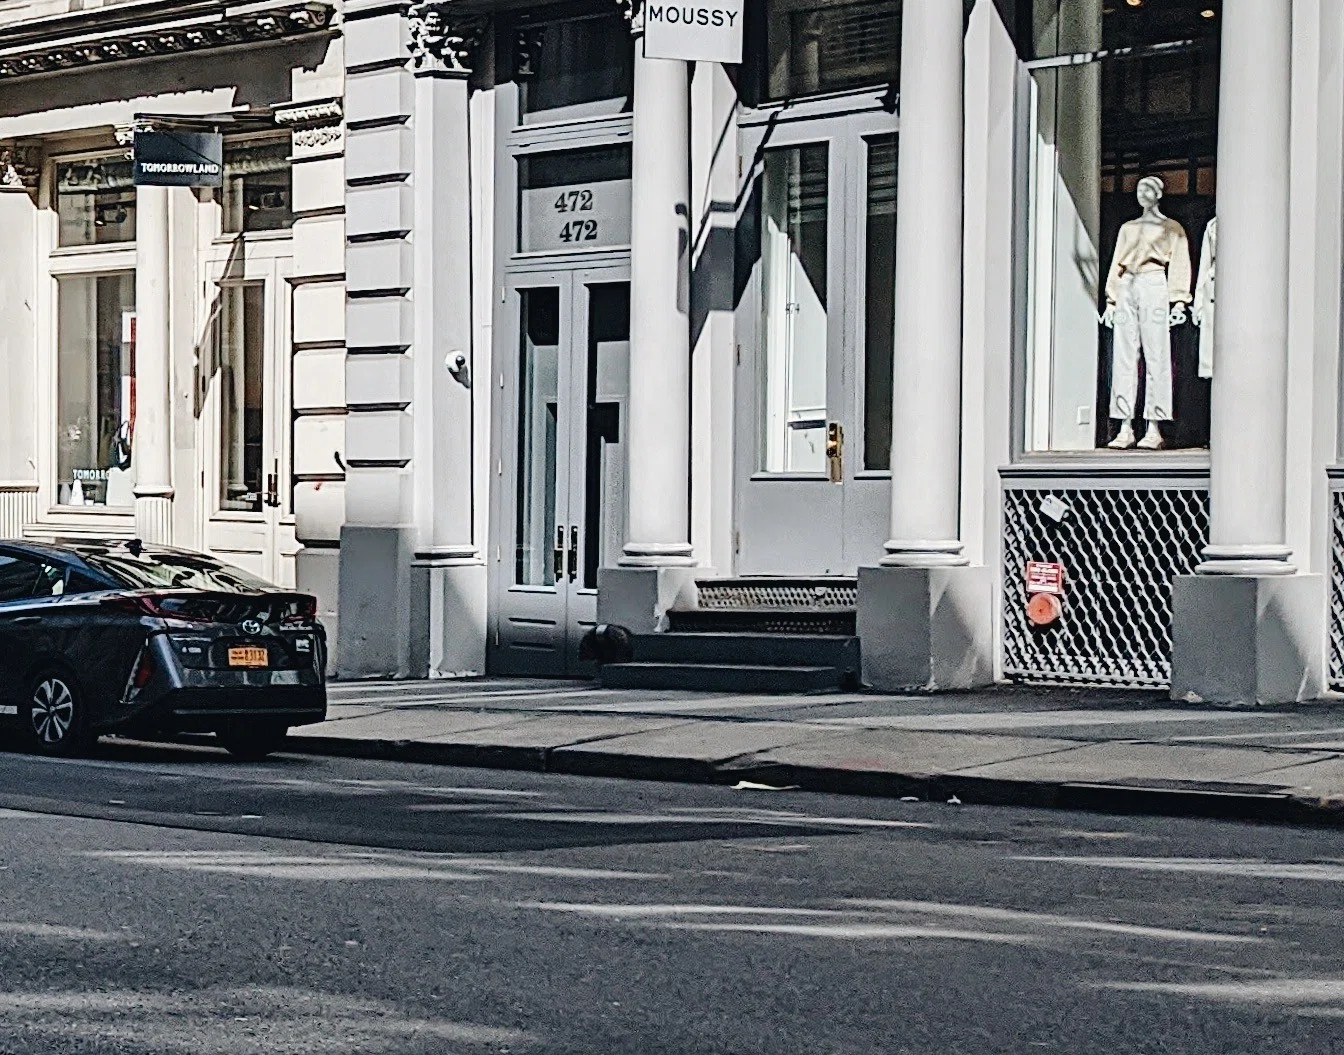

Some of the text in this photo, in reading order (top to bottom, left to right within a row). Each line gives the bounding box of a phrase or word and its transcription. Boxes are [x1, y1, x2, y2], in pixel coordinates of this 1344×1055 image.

[648, 5, 739, 27] MOUSSY
[140, 162, 220, 174] TOMORROWLAND
[554, 190, 593, 213] 472
[559, 219, 598, 243] 472
